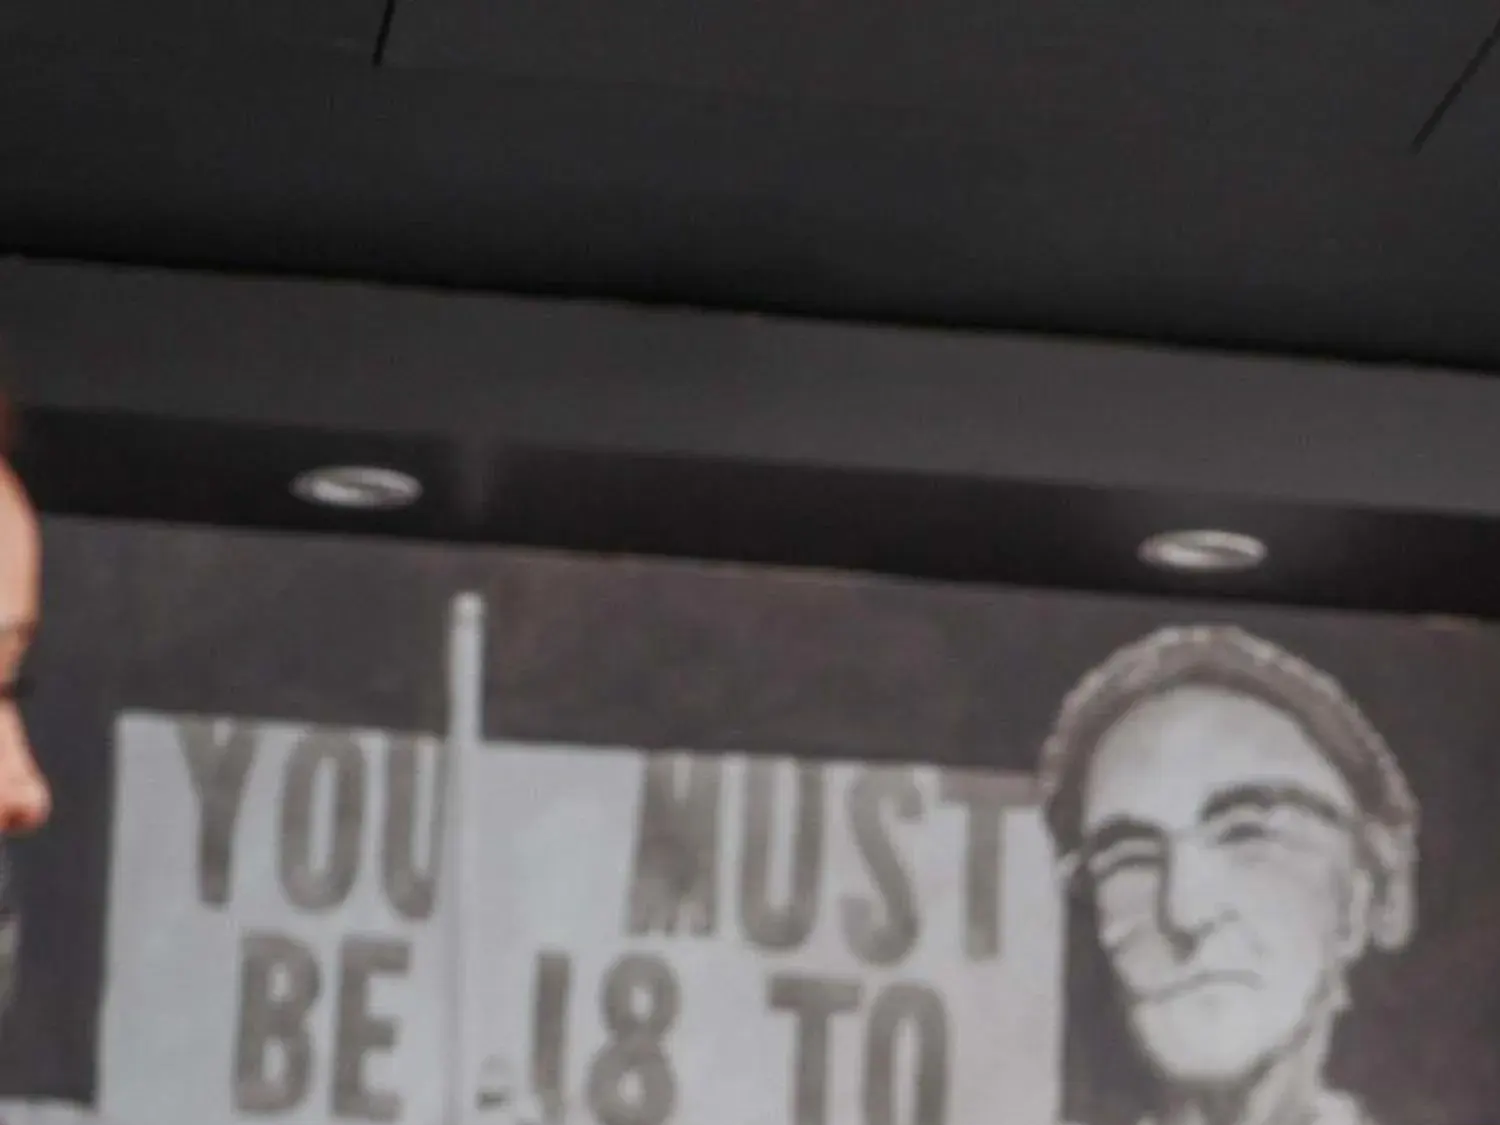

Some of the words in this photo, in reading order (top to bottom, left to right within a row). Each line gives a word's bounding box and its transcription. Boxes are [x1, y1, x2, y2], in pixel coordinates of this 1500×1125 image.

[176, 716, 450, 921] YOU
[624, 750, 1044, 968] MUST
[228, 930, 413, 1124] BE
